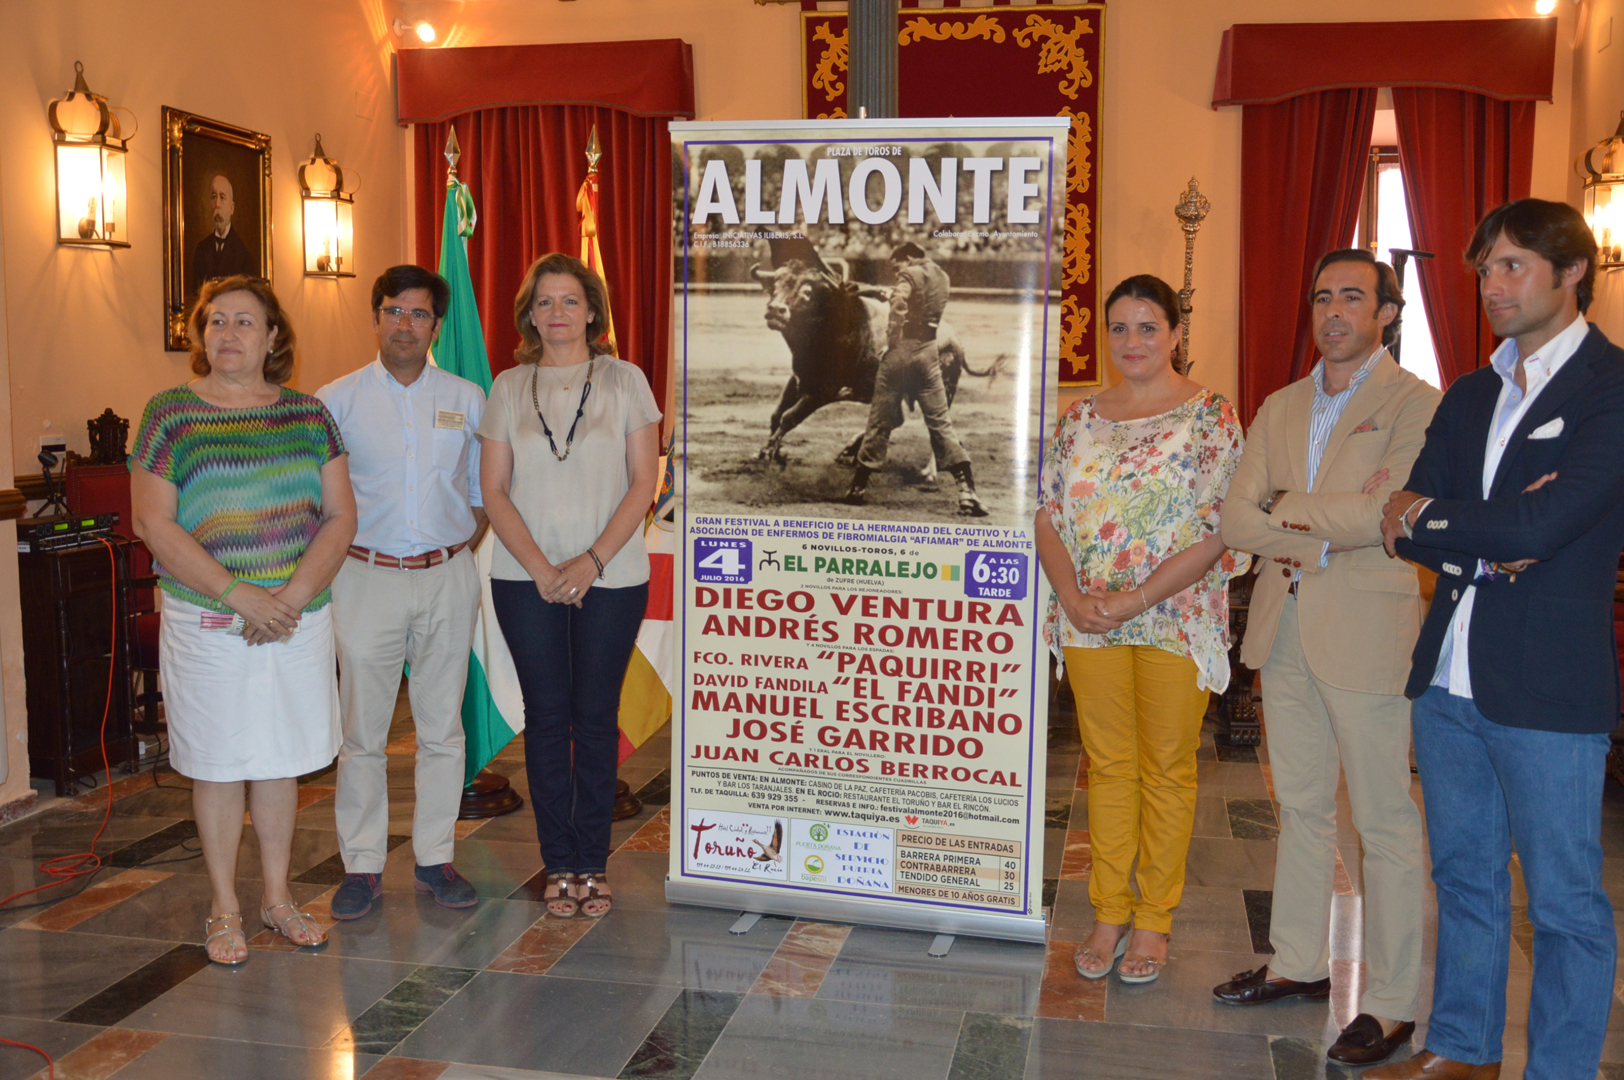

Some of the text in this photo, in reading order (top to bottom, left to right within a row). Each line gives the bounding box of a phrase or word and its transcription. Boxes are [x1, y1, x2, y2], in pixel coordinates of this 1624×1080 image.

[827, 146, 902, 156] PLAZA DE TOROS DE
[692, 157, 1041, 224] ALMONTE
[694, 232, 720, 240] Empresa:
[994, 230, 1038, 239] Ayuntamiento
[689, 526, 1032, 549] ASOCIACIÓN DE ENFERMOS DE FIBROMIALGIA “AFIAMAR” DE ALMONTE
[695, 517, 1026, 538] GRAN FESTIVAL A BENEFICIO DE LA HERMANDAD DEL CAUTIVO Y LA
[810, 544, 897, 554] NOVILLOS-TOROS,
[698, 548, 745, 575] 4
[784, 555, 938, 579] EL PARRALEJO
[972, 554, 1020, 585] 6:30
[978, 587, 1011, 597] TARDE
[695, 586, 1023, 626] DIEGO VENTURA
[701, 614, 1014, 654] ANDRÉS ROMERO
[694, 650, 1022, 684] FCO. RIVERA “PAQUIRRI”
[694, 673, 1018, 708] DAVID FANDILA “EL FANDI”
[691, 690, 1022, 735] MANUEL ESCRIBANO
[726, 718, 983, 759] JOSÉ GARRIDO
[691, 745, 1022, 787] JUAN CARLOS BERROCAL
[837, 772, 892, 781] CORRESPONDIENTES
[691, 770, 720, 779] PUNTOS
[732, 774, 758, 782] VENTA:
[770, 777, 808, 787] ALMONTE:
[808, 781, 832, 789] CASINO
[869, 786, 906, 796] CAFETERÍA
[907, 790, 939, 799] PACOBIS,
[939, 793, 977, 802] CAFETERÍA
[993, 798, 1018, 806] LUCIOS
[752, 784, 793, 793] TARANJALES.
[817, 790, 842, 798] ROCIO:
[843, 792, 890, 803] RESTAURANTE
[902, 798, 930, 807] TORUÑO
[962, 804, 990, 812] RINCÓN.
[715, 789, 750, 798] TAQUILLA:
[784, 794, 798, 802] 355
[816, 799, 850, 808] RESERVAS
[880, 804, 1020, 824] festivalalmonte2016@hotmail.com
[748, 802, 769, 810] VENTA
[786, 806, 822, 815] INTERNET:
[824, 810, 900, 823] www.taquiya.es
[691, 818, 757, 860] Toruño
[837, 829, 890, 840] ESTACIÓN
[901, 834, 1014, 853] PRECIO DE LAS ENTRADAS
[854, 842, 870, 851] DE
[835, 853, 889, 865] SERVICIO
[900, 850, 1016, 870] BARRERA PRIMERA 40
[842, 865, 883, 875] PUERTA
[900, 860, 1015, 880] CONTRABARRERA 30
[900, 871, 1014, 890] TENDIDO GENERAL 25
[838, 876, 889, 889] DOÑANA
[898, 886, 1015, 905] MENORES DE 10 AÑOS GRATIS
